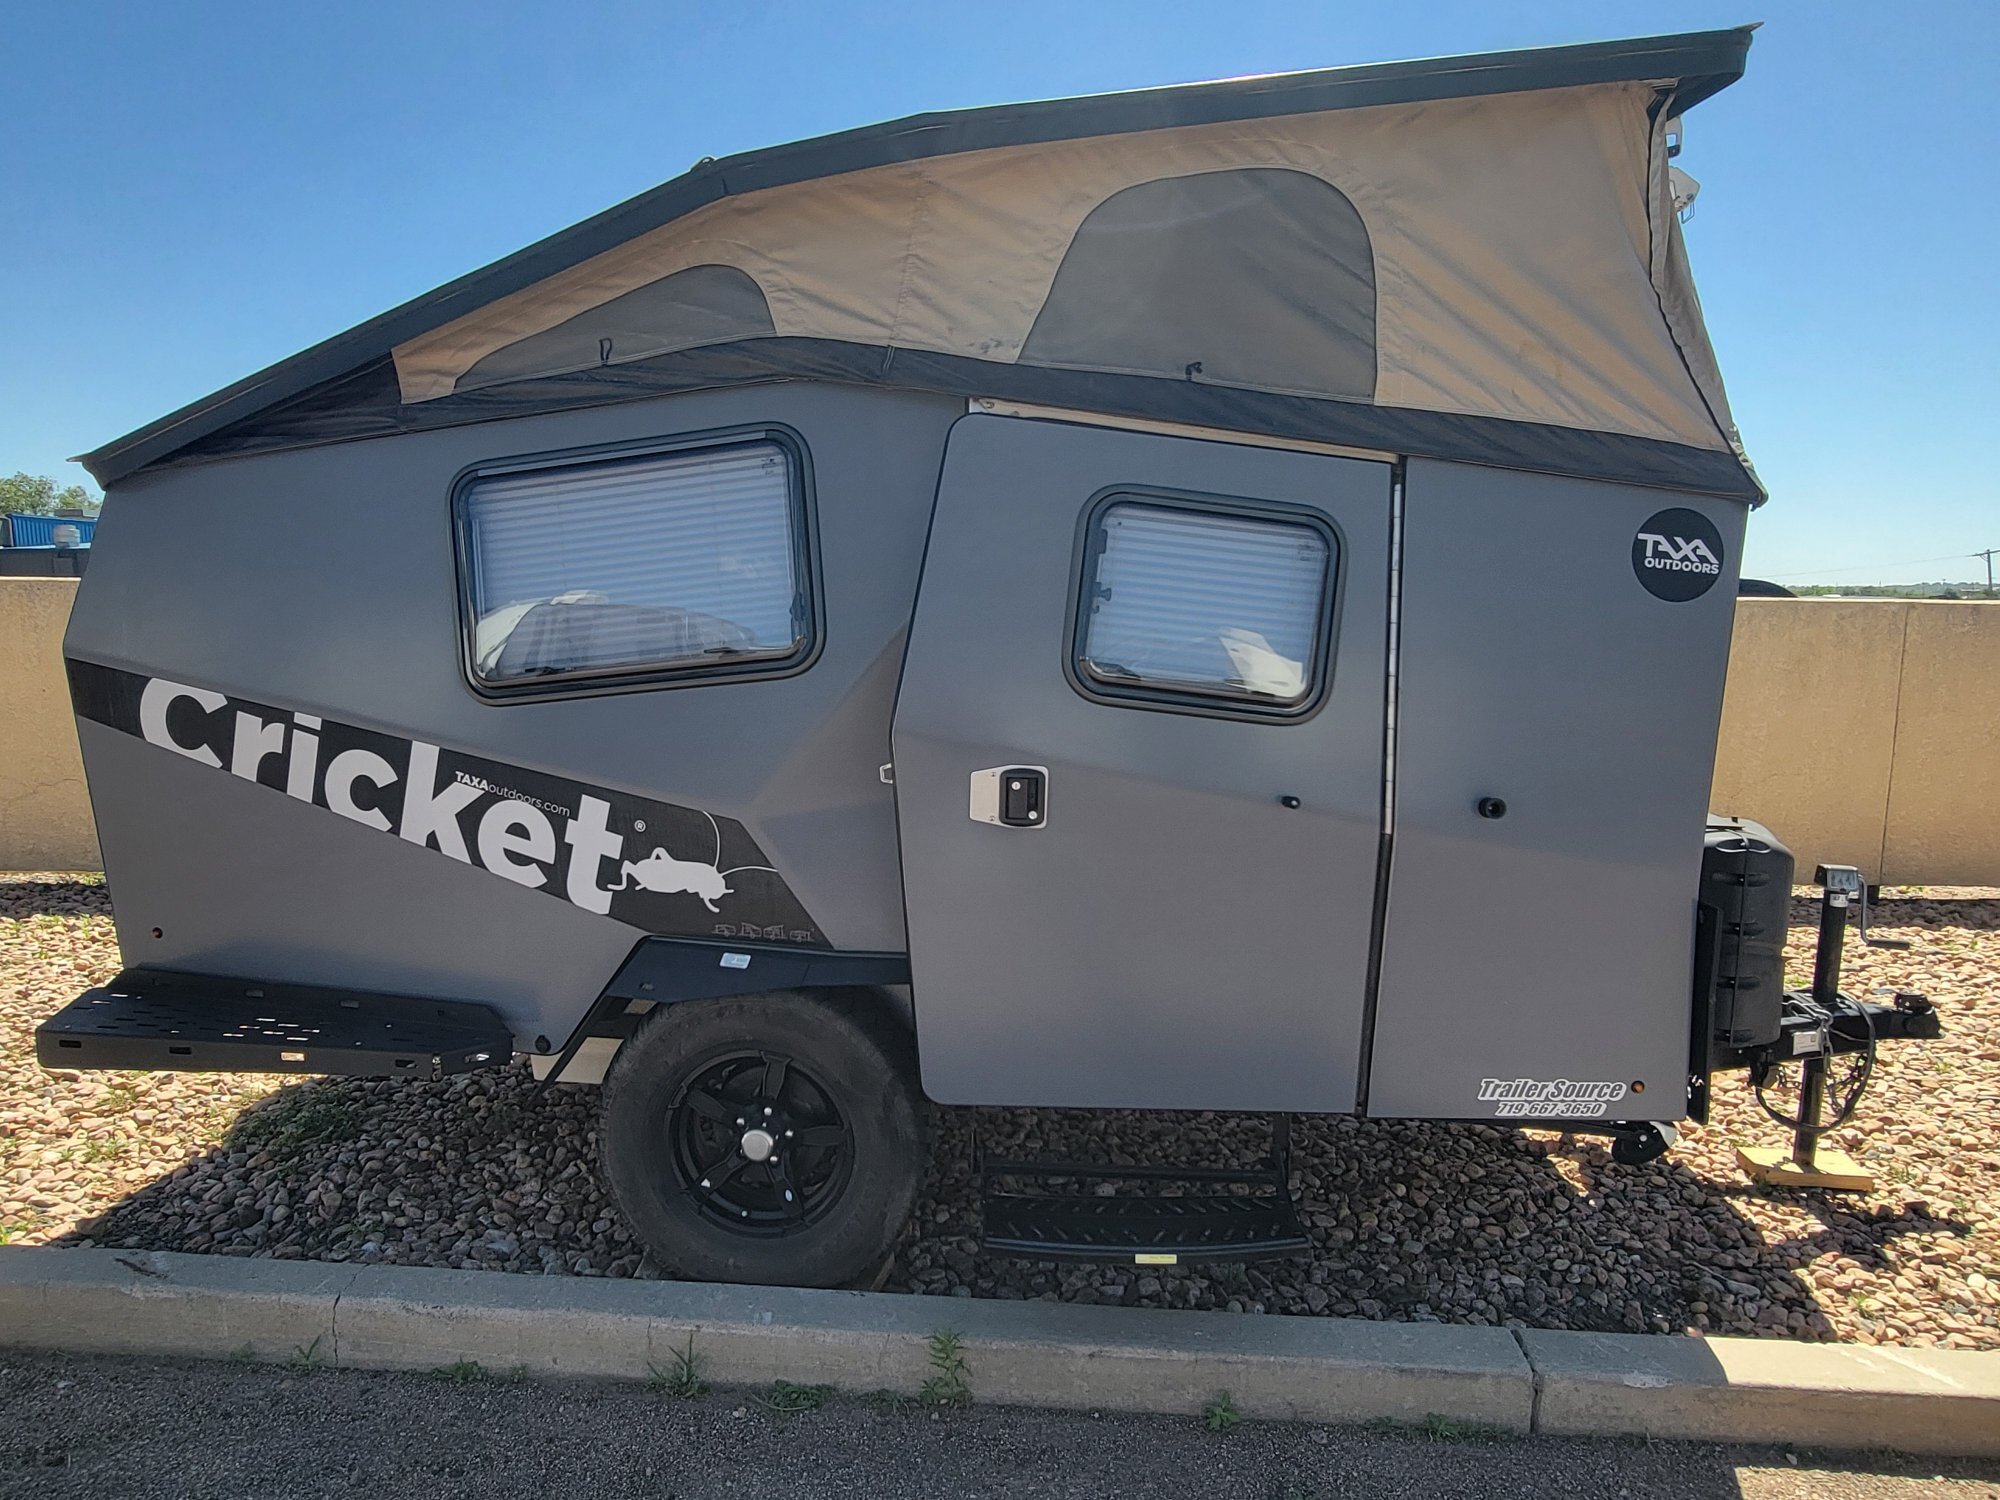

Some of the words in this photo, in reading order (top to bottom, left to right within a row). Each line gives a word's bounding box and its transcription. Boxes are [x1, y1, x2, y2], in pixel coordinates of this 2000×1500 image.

[1637, 532, 1719, 564] TAXA
[1644, 557, 1719, 575] OUTDOORS
[455, 770, 571, 817] TAXAoutdoors.com
